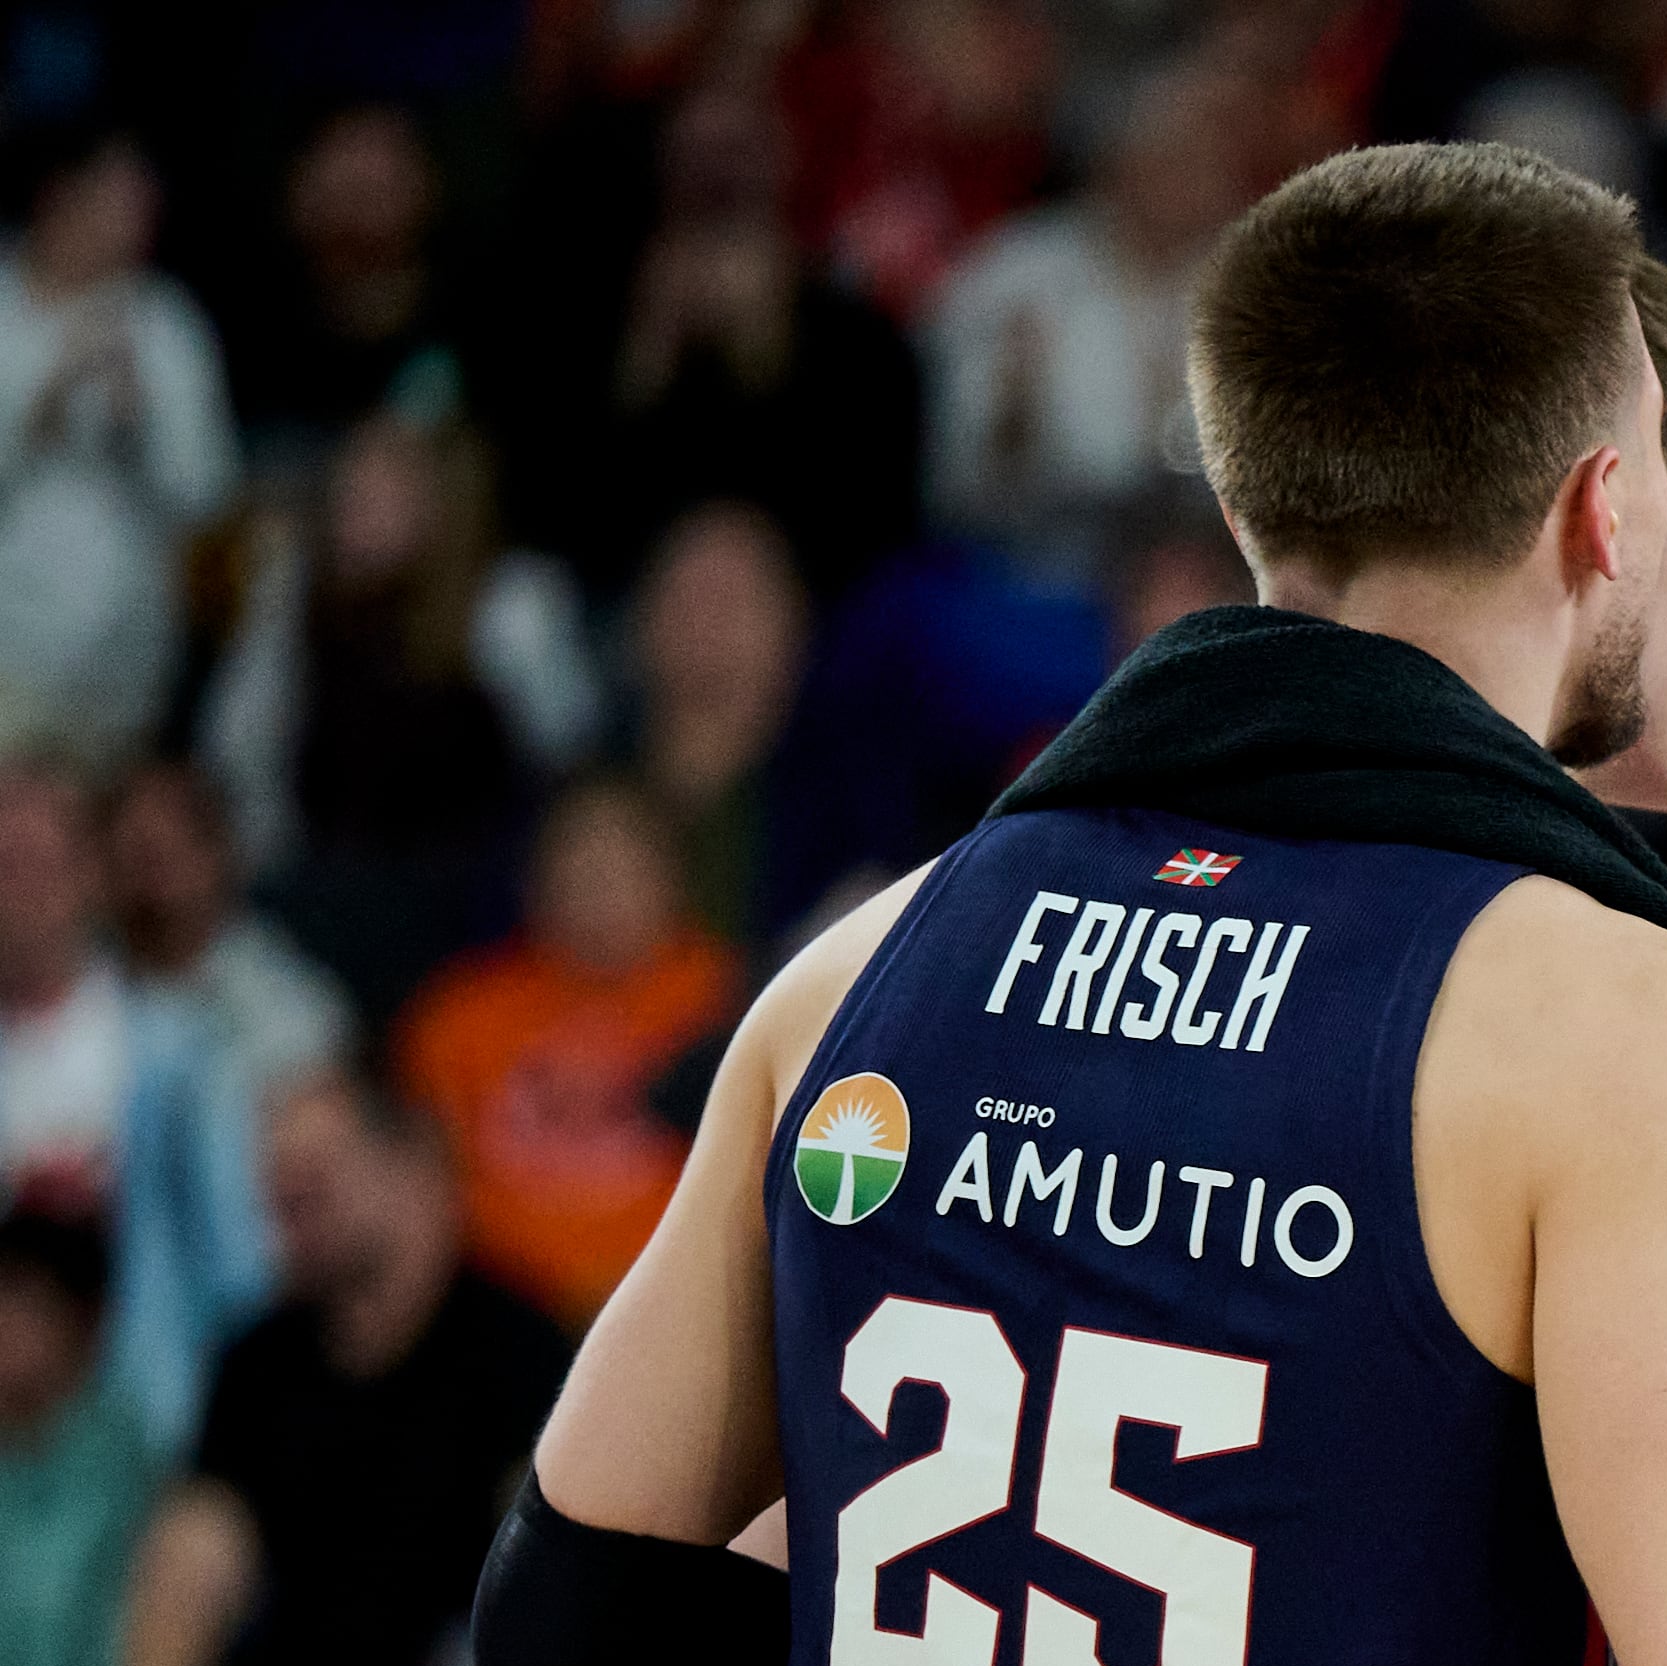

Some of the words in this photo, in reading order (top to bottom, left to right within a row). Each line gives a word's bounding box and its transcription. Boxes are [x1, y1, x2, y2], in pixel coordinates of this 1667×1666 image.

[985, 890, 1310, 1052] FRISCH
[975, 1096, 1057, 1129] GRUPO
[935, 1131, 1354, 1278] AMUTIO
